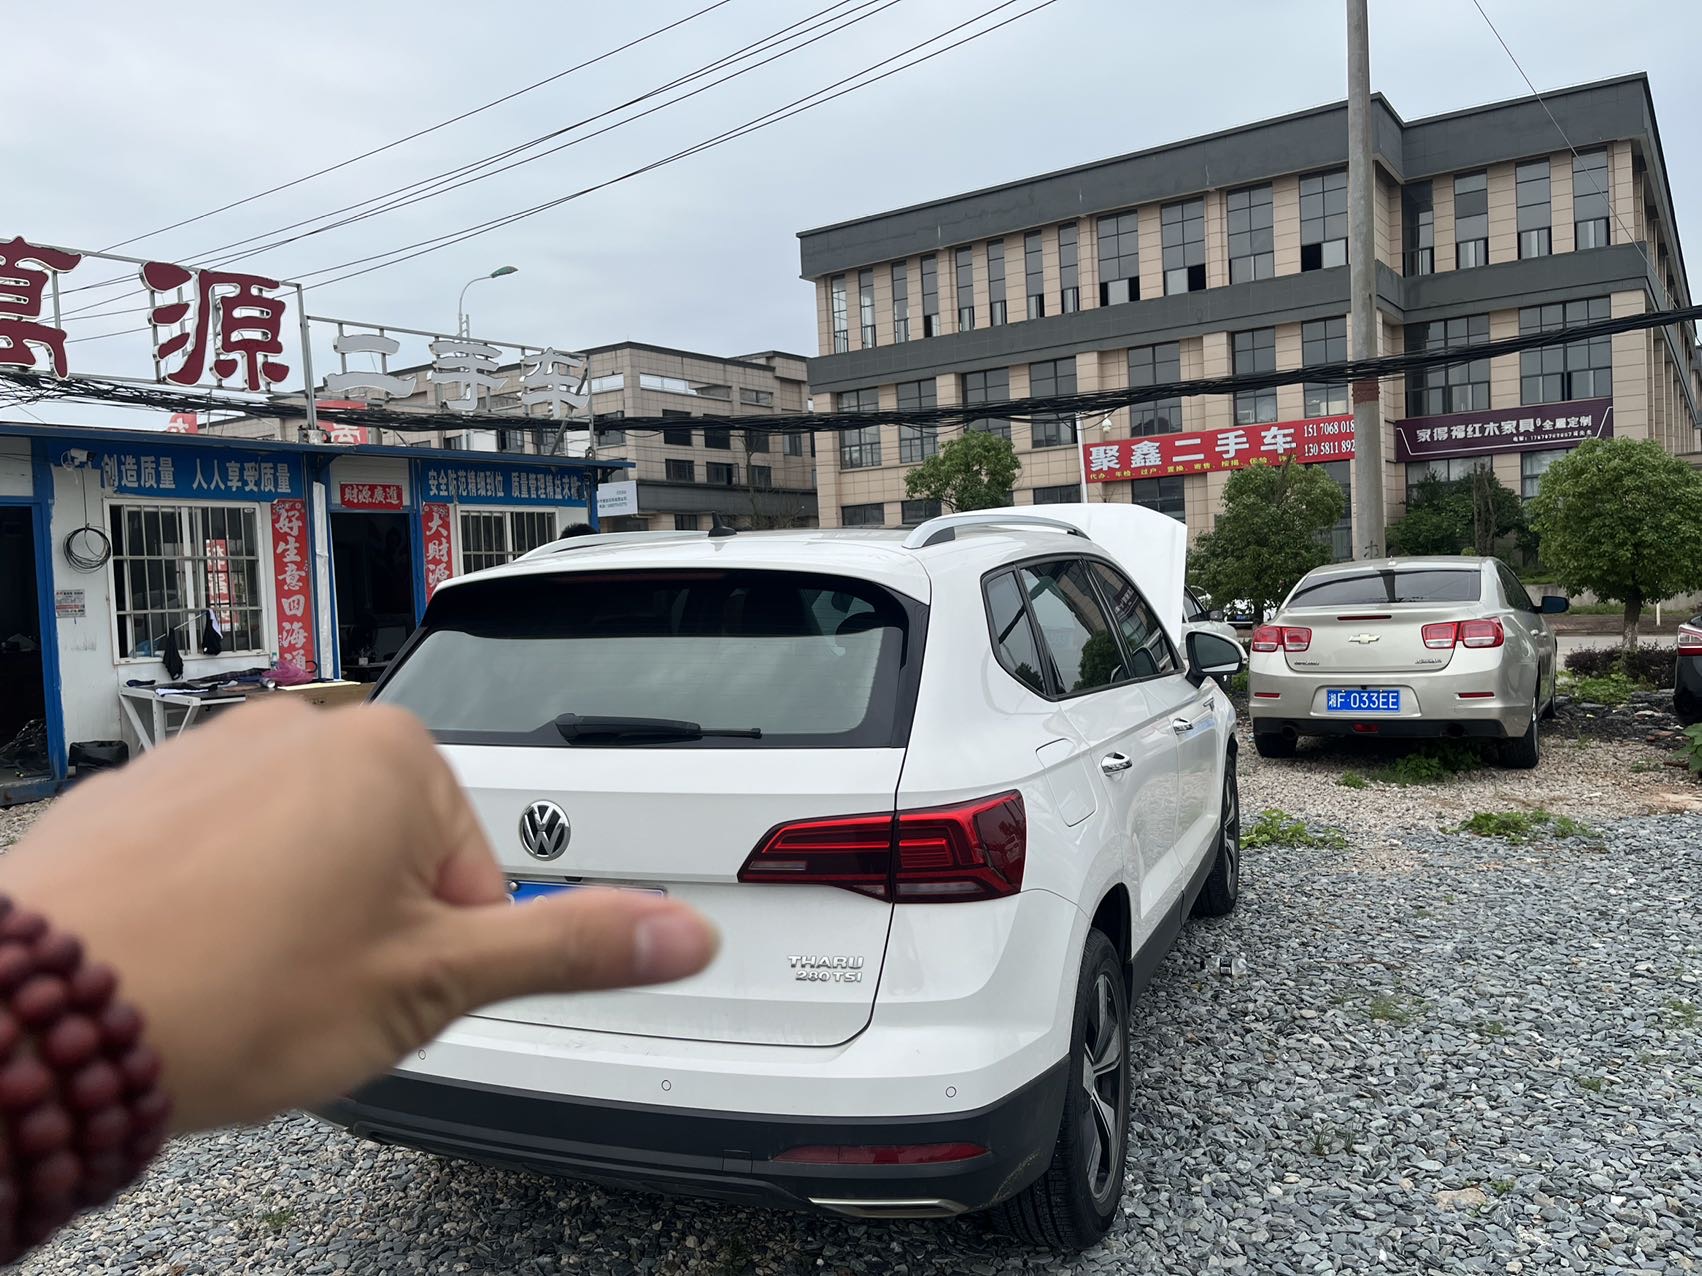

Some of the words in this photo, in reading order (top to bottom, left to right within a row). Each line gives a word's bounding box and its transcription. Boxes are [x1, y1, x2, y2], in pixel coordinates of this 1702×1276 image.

[322, 334, 592, 420] 二手车
[1303, 425, 1317, 437] 151
[1320, 422, 1339, 434] 7068
[1542, 414, 1592, 431] 全屋定制
[1089, 426, 1297, 472] 聚鑫二手车
[1304, 443, 1319, 456] 130
[1320, 442, 1339, 455] 5811
[102, 454, 176, 489] 创造质量
[192, 458, 292, 493] 人人享受质量
[788, 955, 864, 969] THARU
[796, 970, 831, 982] 280
[832, 971, 863, 983] TSI
